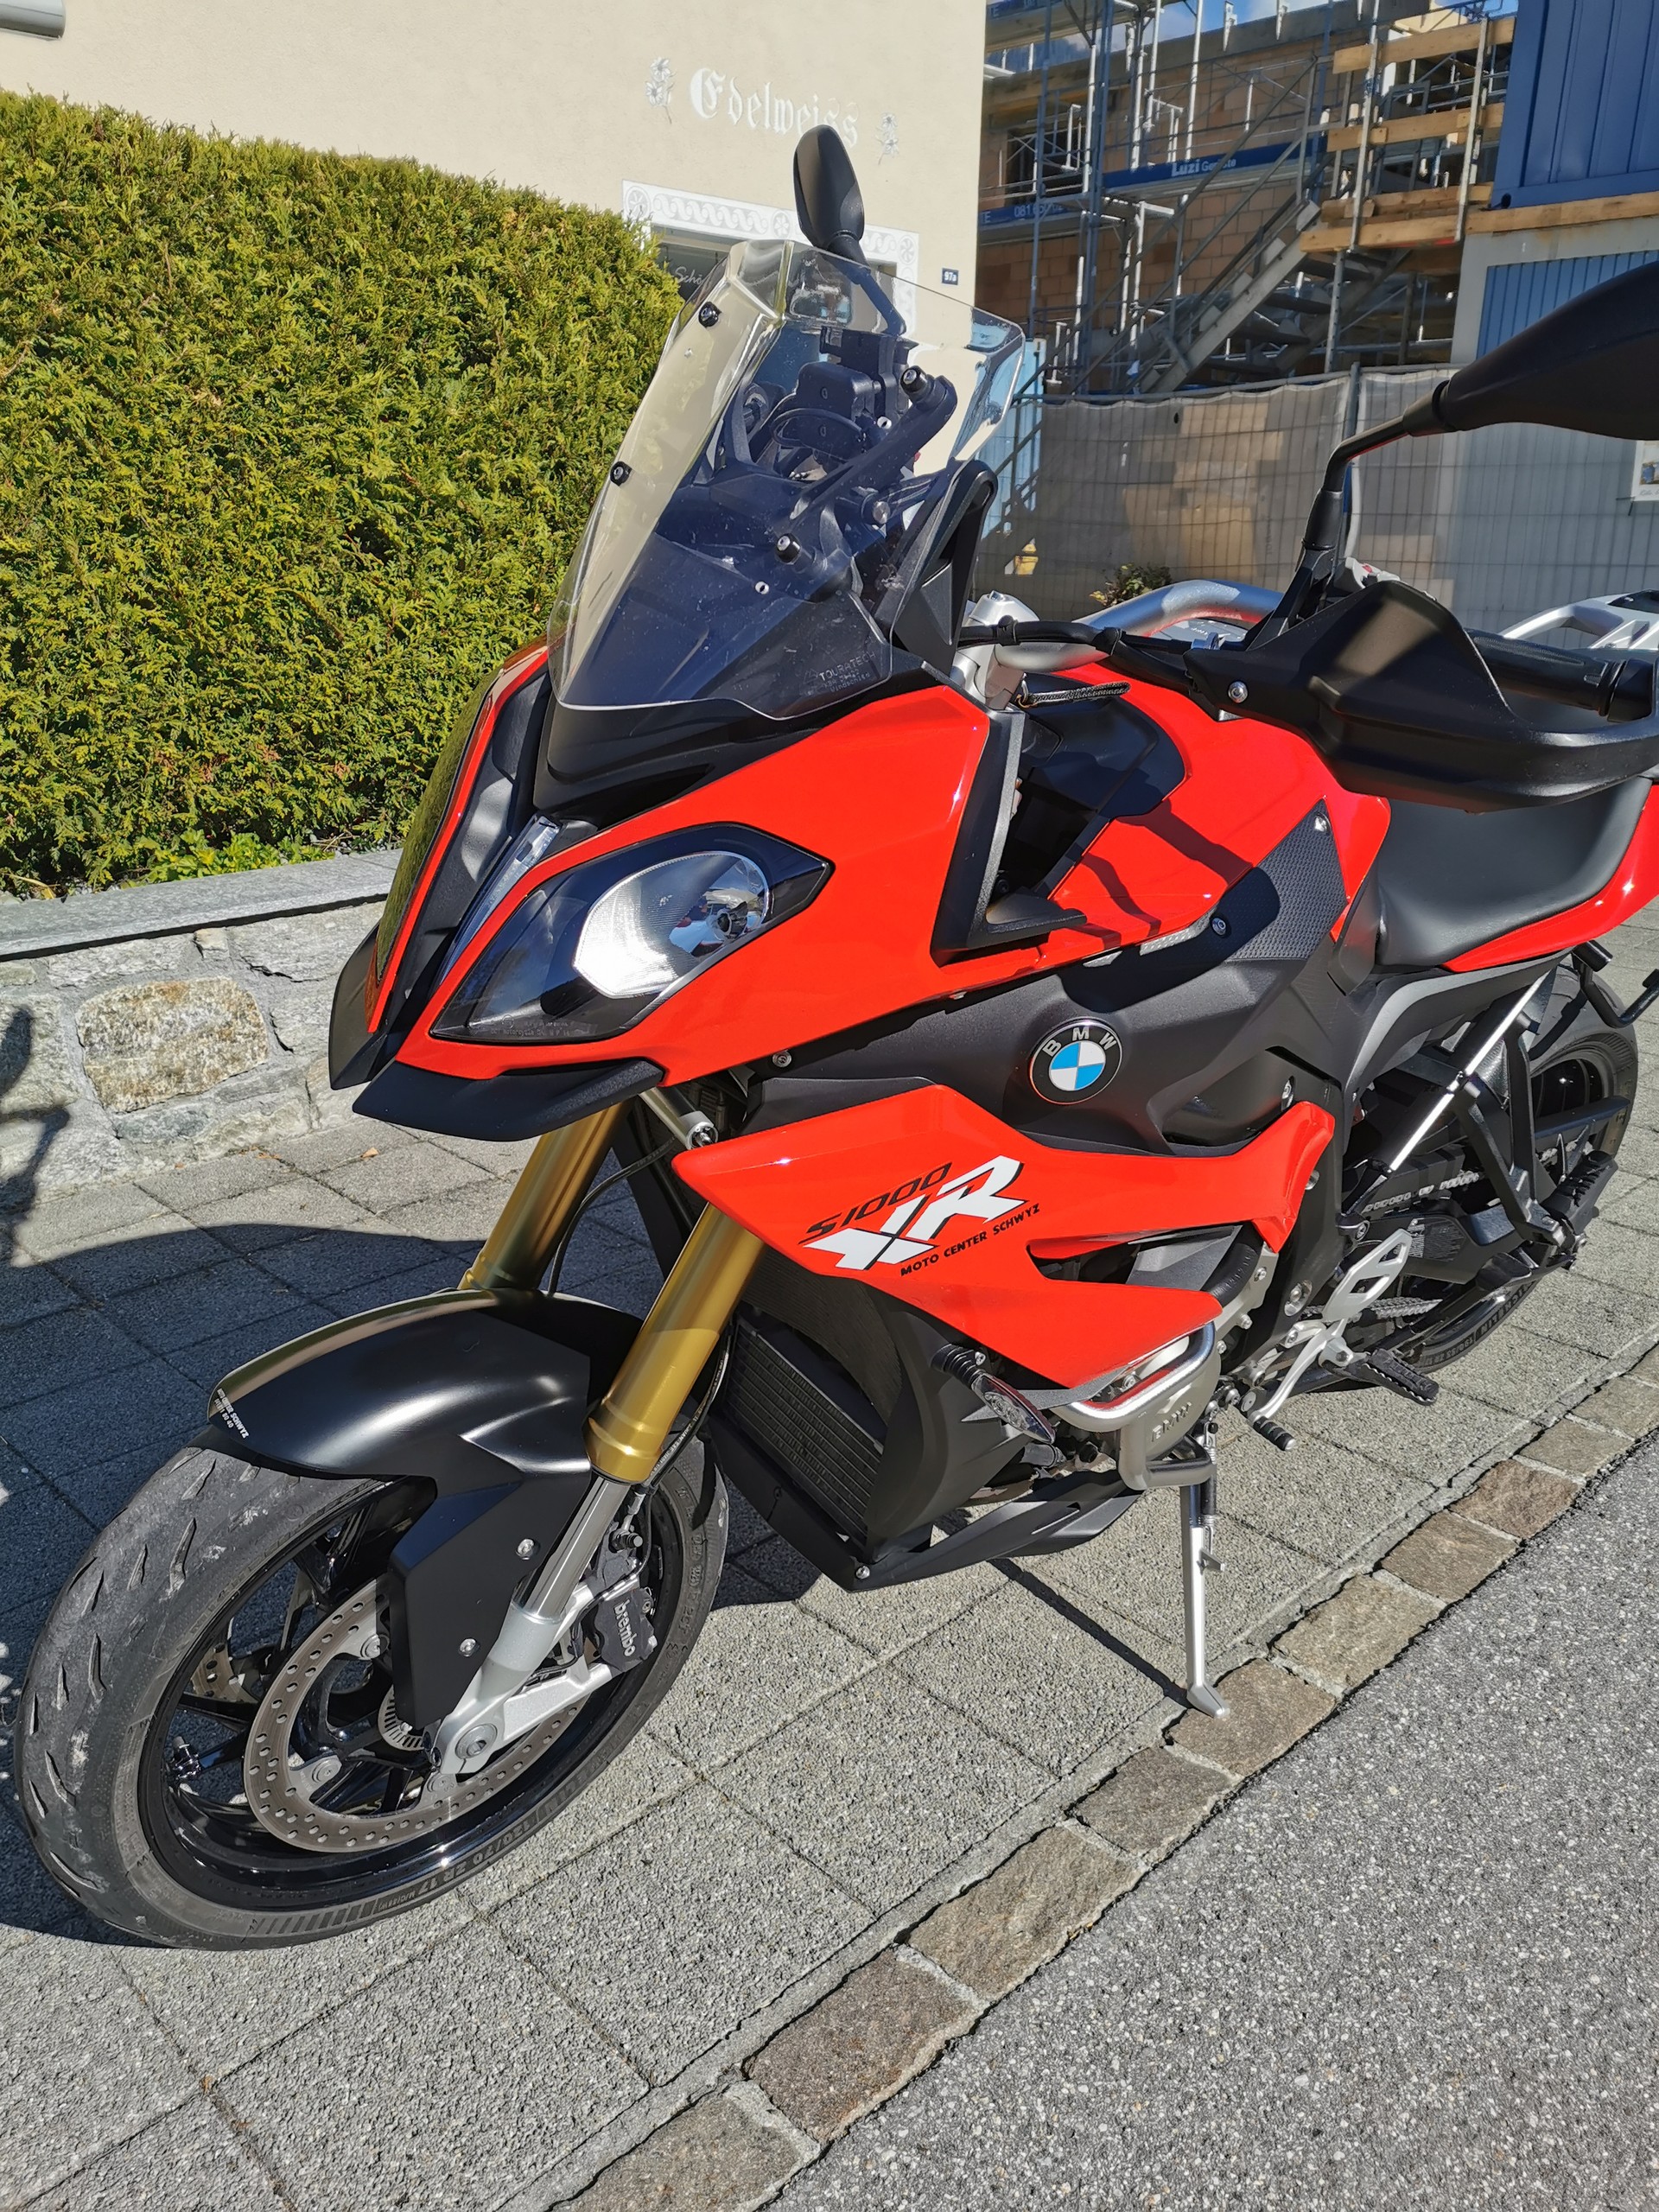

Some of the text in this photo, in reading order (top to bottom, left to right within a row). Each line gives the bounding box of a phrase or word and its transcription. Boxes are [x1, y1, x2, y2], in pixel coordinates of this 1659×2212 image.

[690, 67, 860, 148] Edelweiss
[1171, 159, 1200, 176] Luzi
[944, 270, 957, 282] 97a
[819, 651, 876, 681] TOURATECH
[1042, 1026, 1117, 1057] BMW
[798, 1161, 953, 1245] S1000
[802, 1154, 1030, 1271] XR
[900, 1203, 1040, 1277] MOTO CENTER SCHWYZ
[230, 1412, 250, 1439] SCHWYZ
[1151, 1402, 1192, 1442] BMW
[613, 1599, 638, 1656] brembo
[473, 1820, 530, 1864] 120/70
[417, 1875, 439, 1893] 17
[442, 1860, 467, 1882] ZR
